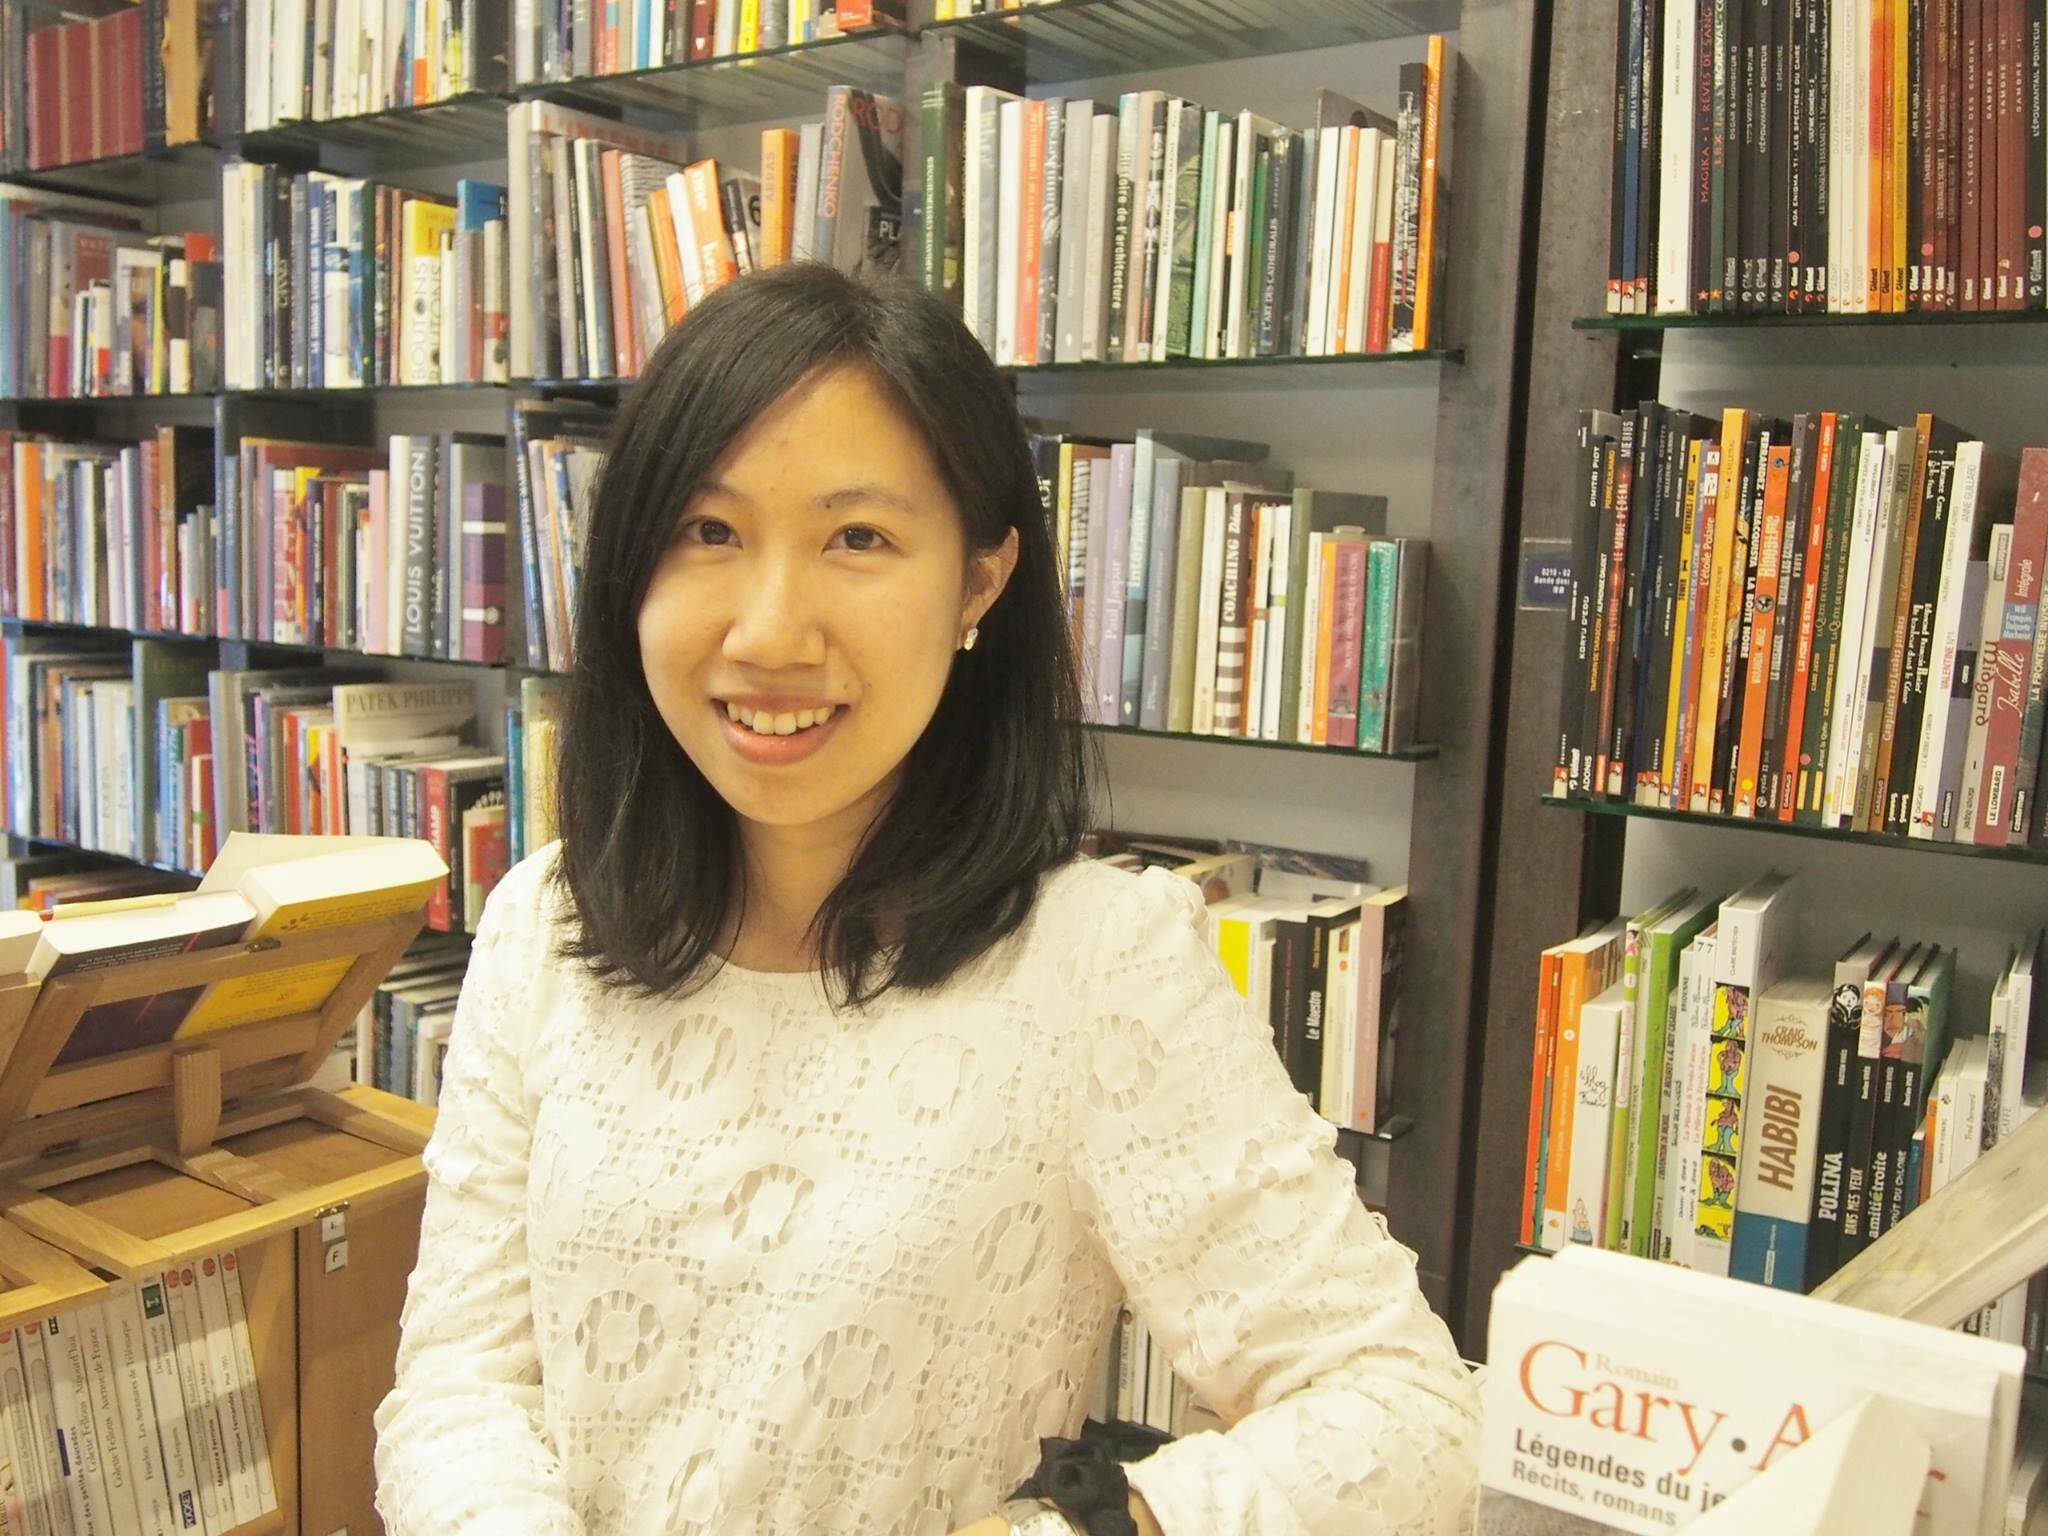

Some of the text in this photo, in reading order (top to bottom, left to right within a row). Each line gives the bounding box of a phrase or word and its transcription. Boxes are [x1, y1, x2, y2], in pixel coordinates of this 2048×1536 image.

[1703, 7, 1713, 48] SANG
[2032, 20, 2041, 68] POINTEUR
[1760, 44, 1768, 89] POINTEUR
[1794, 73, 1801, 86] DU
[1968, 39, 1976, 90] SAMBRE
[2015, 61, 2023, 113] SAMBRE
[1793, 87, 1801, 132] SPECTRES
[1985, 69, 1993, 120] SAMBRE
[1999, 63, 2007, 115] SAMBRE
[822, 93, 849, 219] RODCHENKO
[1700, 146, 1710, 204] MAGIKA
[1965, 127, 1974, 184] LÉGENDE
[1967, 190, 1974, 206] LA
[1110, 152, 1133, 309] Histoire de l'architecture
[1263, 217, 1279, 282] CATHÉDRALES
[1262, 282, 1275, 303] DES
[1260, 303, 1273, 332] L'ART
[1589, 445, 1601, 508] DIMITRI PIOT
[1960, 463, 1977, 522] ANNE GUILLARD
[405, 452, 427, 635] LOUIS VUITTON
[1613, 523, 1626, 562] LE MONDE
[1702, 517, 1716, 550] Polaire
[1739, 431, 1770, 659] FERRANDEZ BENACQUISTA LA BOITE NOIRE
[1222, 538, 1241, 623] COACHING
[1698, 550, 1712, 587] L'étoile
[2014, 558, 2034, 598] Intégrale
[1105, 559, 1125, 640] Paul Jaspar
[1596, 579, 1605, 613] ALPHONSE
[1593, 618, 1602, 652] TARASCON
[1797, 582, 1816, 673] LA MORT DE STALINE
[1589, 661, 1599, 693] TARTARIN
[1721, 666, 1732, 699] MALEK
[1939, 645, 1955, 690] VALENTINE
[1974, 640, 2000, 726] Midgard
[1996, 649, 2025, 719] Isabelle
[345, 692, 396, 713] PATEK
[2031, 686, 2041, 701] LA
[1581, 755, 1593, 792] ADONIS
[1782, 773, 1791, 808] DARGAUD
[1988, 769, 2002, 823] LE LOMBARD
[1874, 779, 1885, 815] DARGAUD
[1304, 990, 1322, 1041] Le Maestro
[1774, 1025, 1805, 1042] CRAIG
[1761, 1032, 1818, 1050] THOMPSON
[1757, 1083, 1803, 1191] HABIBI
[1817, 1152, 1844, 1221] POLINA
[1848, 1167, 1864, 1191] YEUX
[1895, 1150, 1906, 1186] CHLORE
[1846, 1193, 1861, 1212] MES
[1893, 1187, 1903, 1202] DU
[1844, 1213, 1859, 1235] DANS
[1594, 1352, 1680, 1391] Romain
[77, 1401, 95, 1437] Fellous
[87, 1327, 124, 1489] Colette Fellous Avenue de France
[1518, 1339, 1728, 1477] Gary
[81, 1438, 98, 1473] Colette
[1514, 1427, 1646, 1489] Légendes
[1656, 1471, 1691, 1502] du
[1512, 1461, 1677, 1528] Récits, romans
